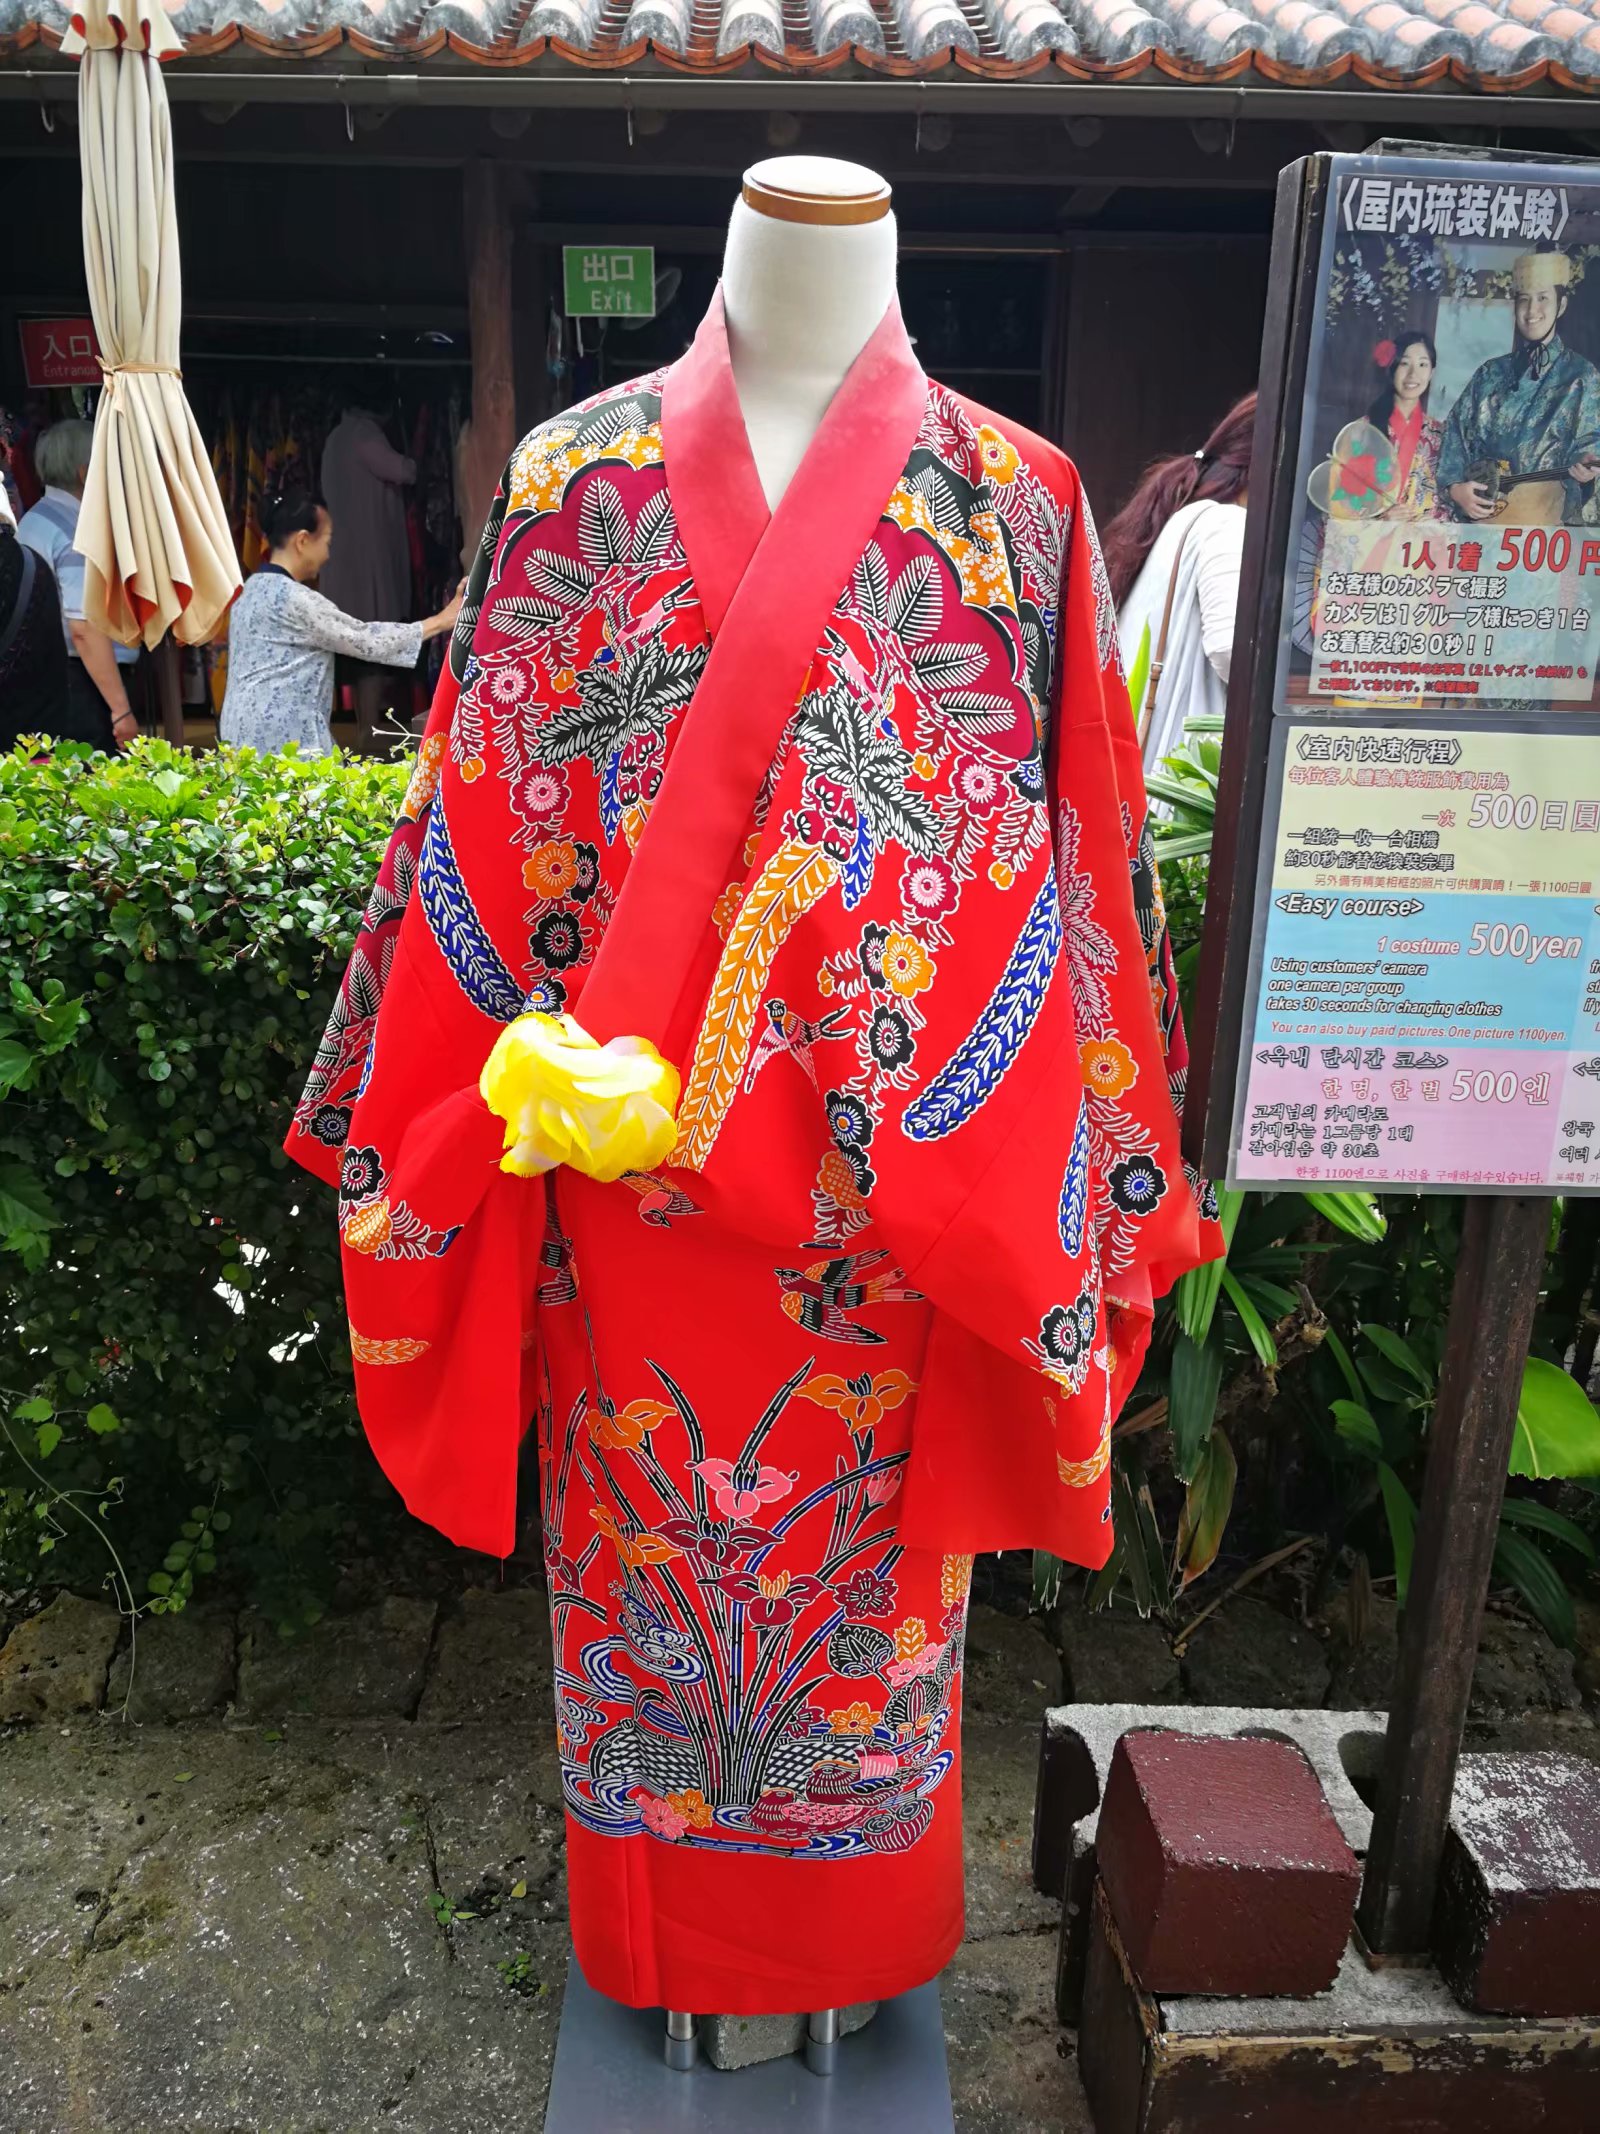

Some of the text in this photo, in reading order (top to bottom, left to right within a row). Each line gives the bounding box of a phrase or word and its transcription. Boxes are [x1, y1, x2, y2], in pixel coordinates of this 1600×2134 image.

[583, 253, 634, 282] 出口
[591, 290, 632, 311] Exit
[43, 334, 91, 360] 入口
[1402, 541, 1436, 571] 1人
[1447, 541, 1482, 572] 1着
[1496, 528, 1572, 573] 500
[1326, 572, 1507, 599] お客様のカメラで撮影
[1421, 808, 1456, 828] 一次
[1275, 892, 1424, 920] <Easy course>
[1377, 936, 1389, 952] 1
[1390, 939, 1460, 955] costume
[1271, 957, 1307, 975] Using
[1381, 964, 1428, 976] camera
[1268, 980, 1404, 996] one camera per group
[1266, 997, 1503, 1018] takes 30 seconds for changing clothes
[1271, 1021, 1293, 1033] You
[1296, 1024, 1316, 1034] can
[1319, 1023, 1344, 1035] also
[1347, 1024, 1368, 1038] buy
[1370, 1025, 1397, 1038] paid
[1473, 1028, 1514, 1040] picture
[1321, 1047, 1386, 1069] 단시간
[1393, 1051, 1449, 1069] 코스>
[1321, 1078, 1342, 1099] 한
[1352, 1078, 1378, 1102] 명,
[1391, 1079, 1412, 1100] 한
[1421, 1080, 1441, 1101] 벌
[1252, 1103, 1389, 1123] 고객님의 카메라로
[1251, 1121, 1415, 1142] 카메라는 1그룹당 1대
[1562, 1120, 1596, 1138] 왕국
[1248, 1139, 1380, 1159] 갈아입음 약 30초
[1559, 1145, 1590, 1163] 여러
[1393, 1169, 1430, 1181] 사진을
